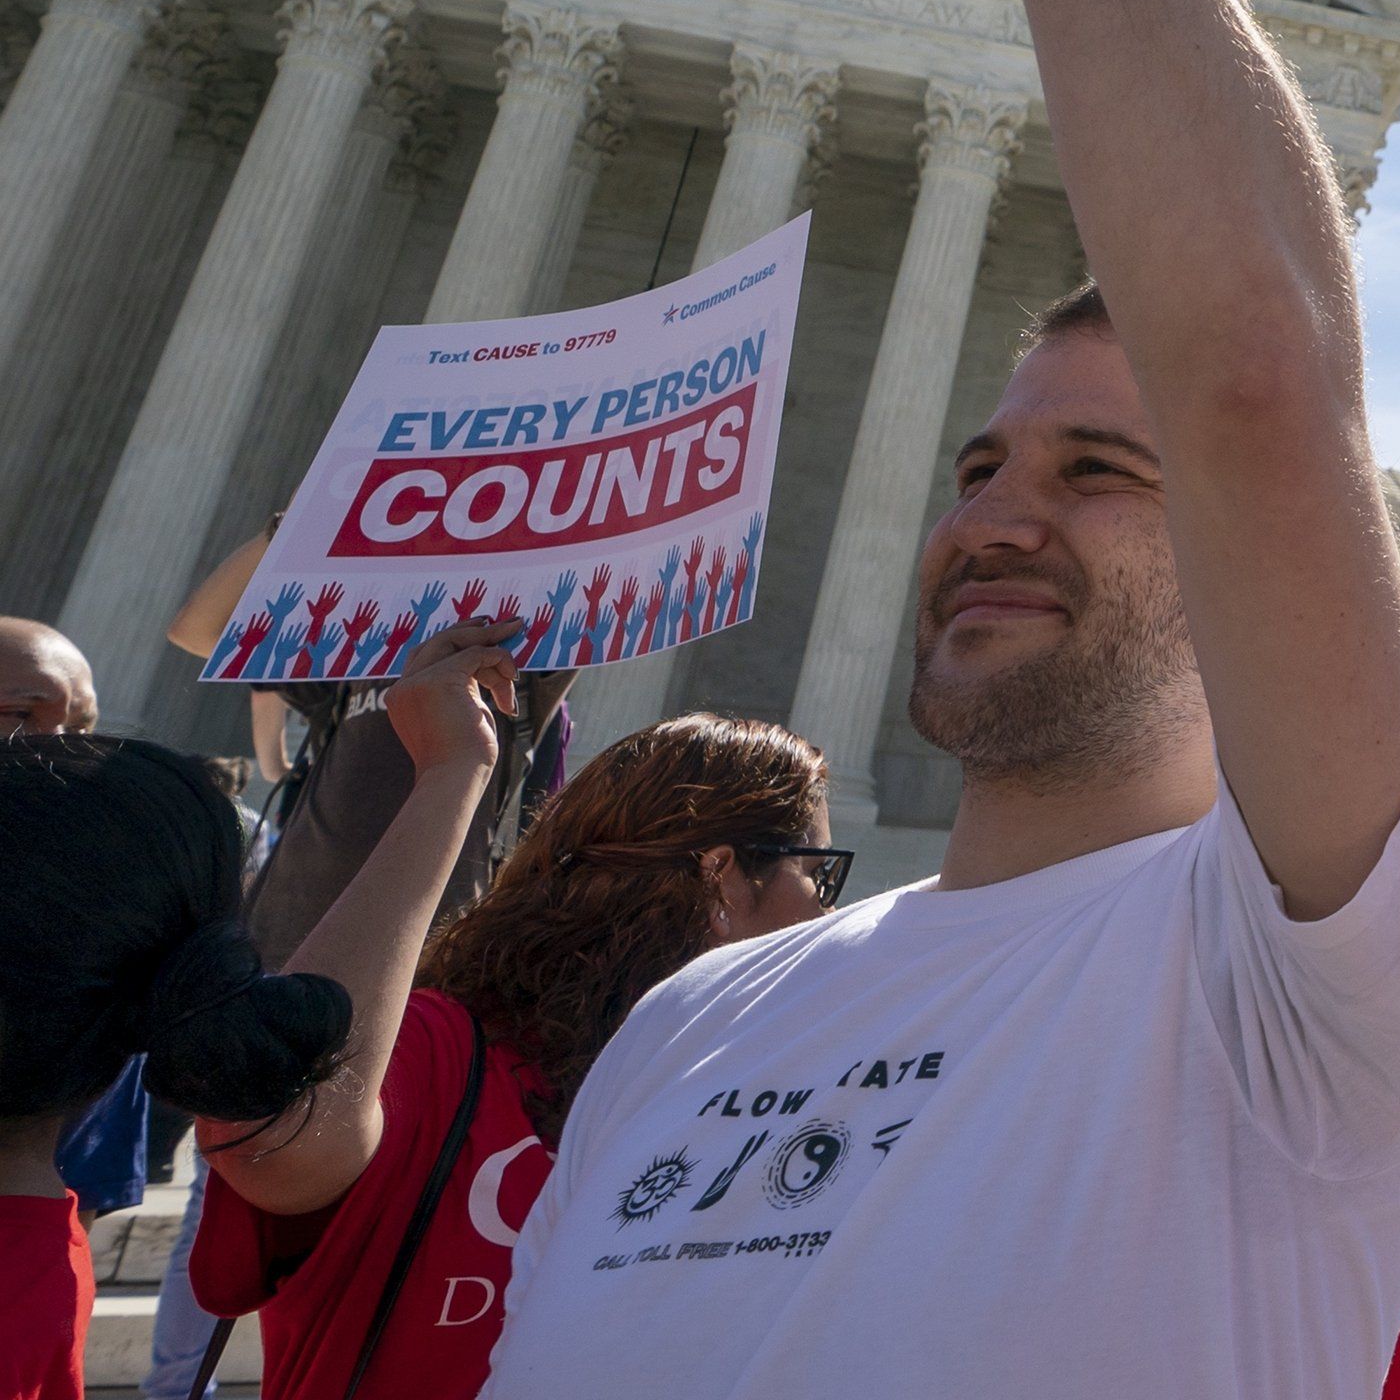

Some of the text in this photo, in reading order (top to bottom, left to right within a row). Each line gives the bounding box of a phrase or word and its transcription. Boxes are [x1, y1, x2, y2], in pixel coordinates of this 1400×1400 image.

[678, 261, 777, 322] Common Cause
[427, 328, 617, 365] Text CAUSE to 97779
[376, 396, 591, 453] EVERY
[590, 328, 769, 437] PERSON
[358, 404, 745, 545] COUNTS
[696, 1087, 816, 1118] FLOW
[675, 1240, 736, 1261] FREE
